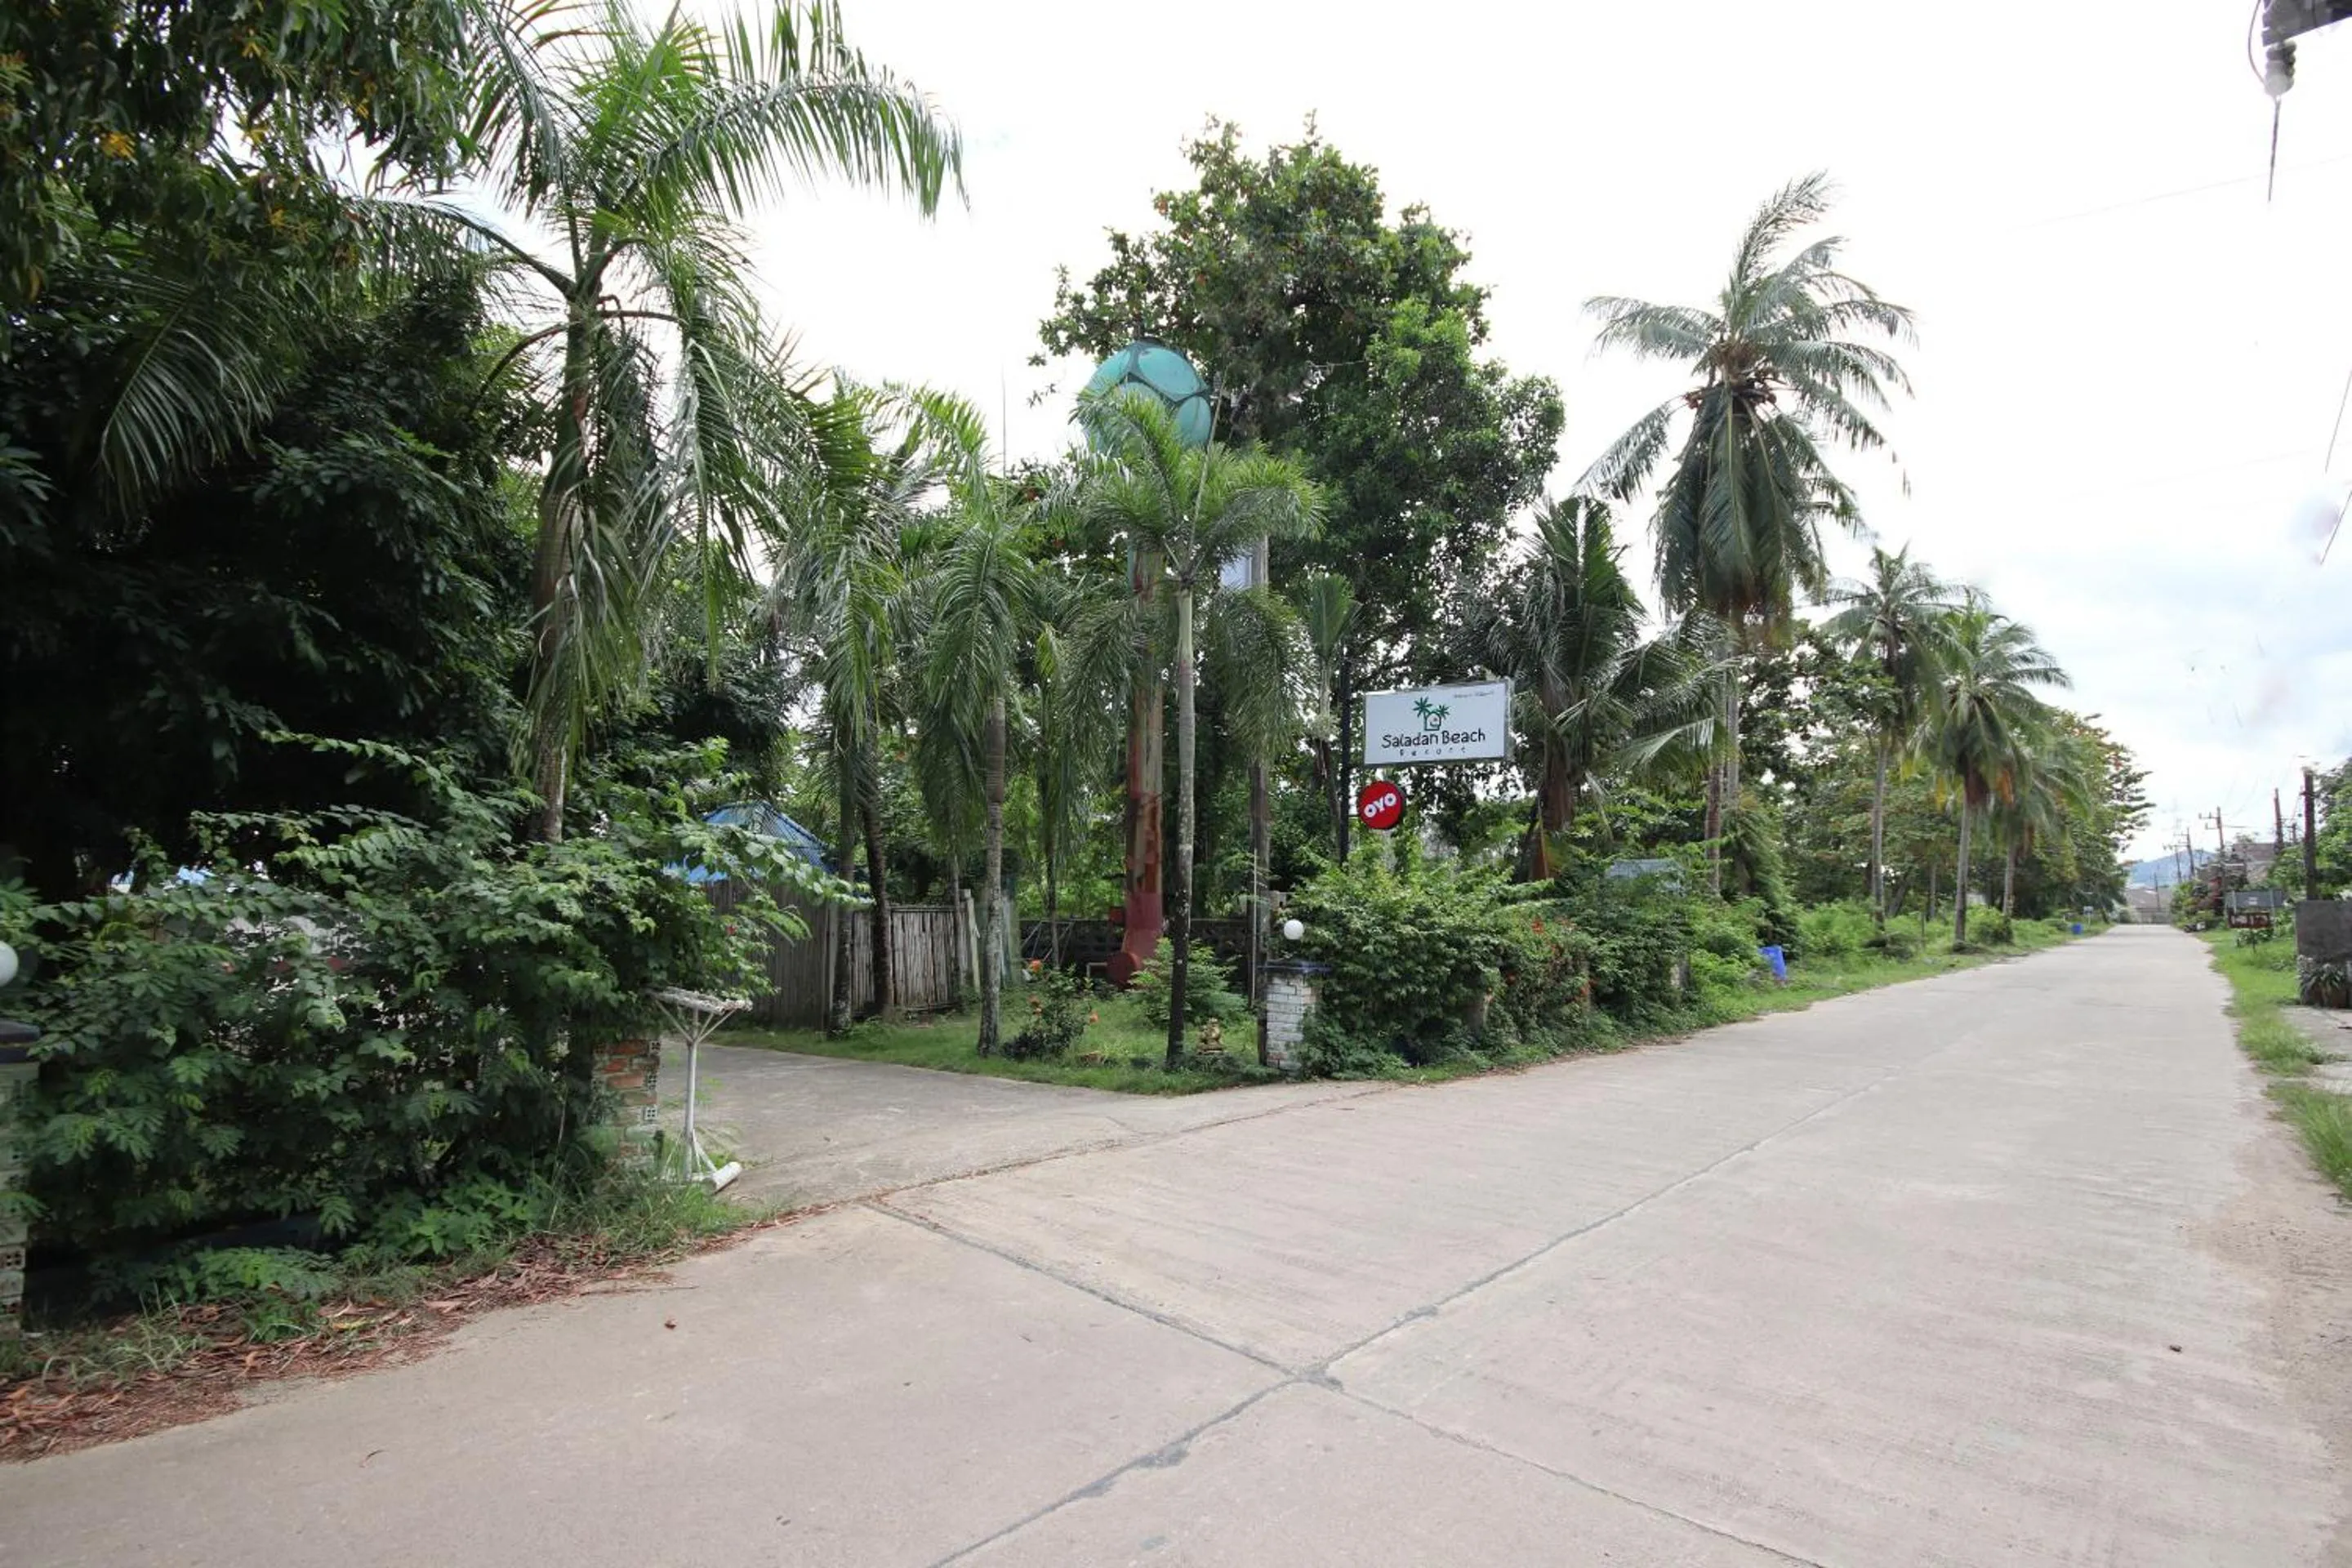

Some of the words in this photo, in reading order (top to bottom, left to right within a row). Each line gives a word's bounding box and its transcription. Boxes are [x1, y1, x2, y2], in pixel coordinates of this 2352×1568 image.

[1381, 732, 1438, 749] Saladan
[1441, 728, 1486, 744] Beach
[1364, 792, 1396, 817] OYO
